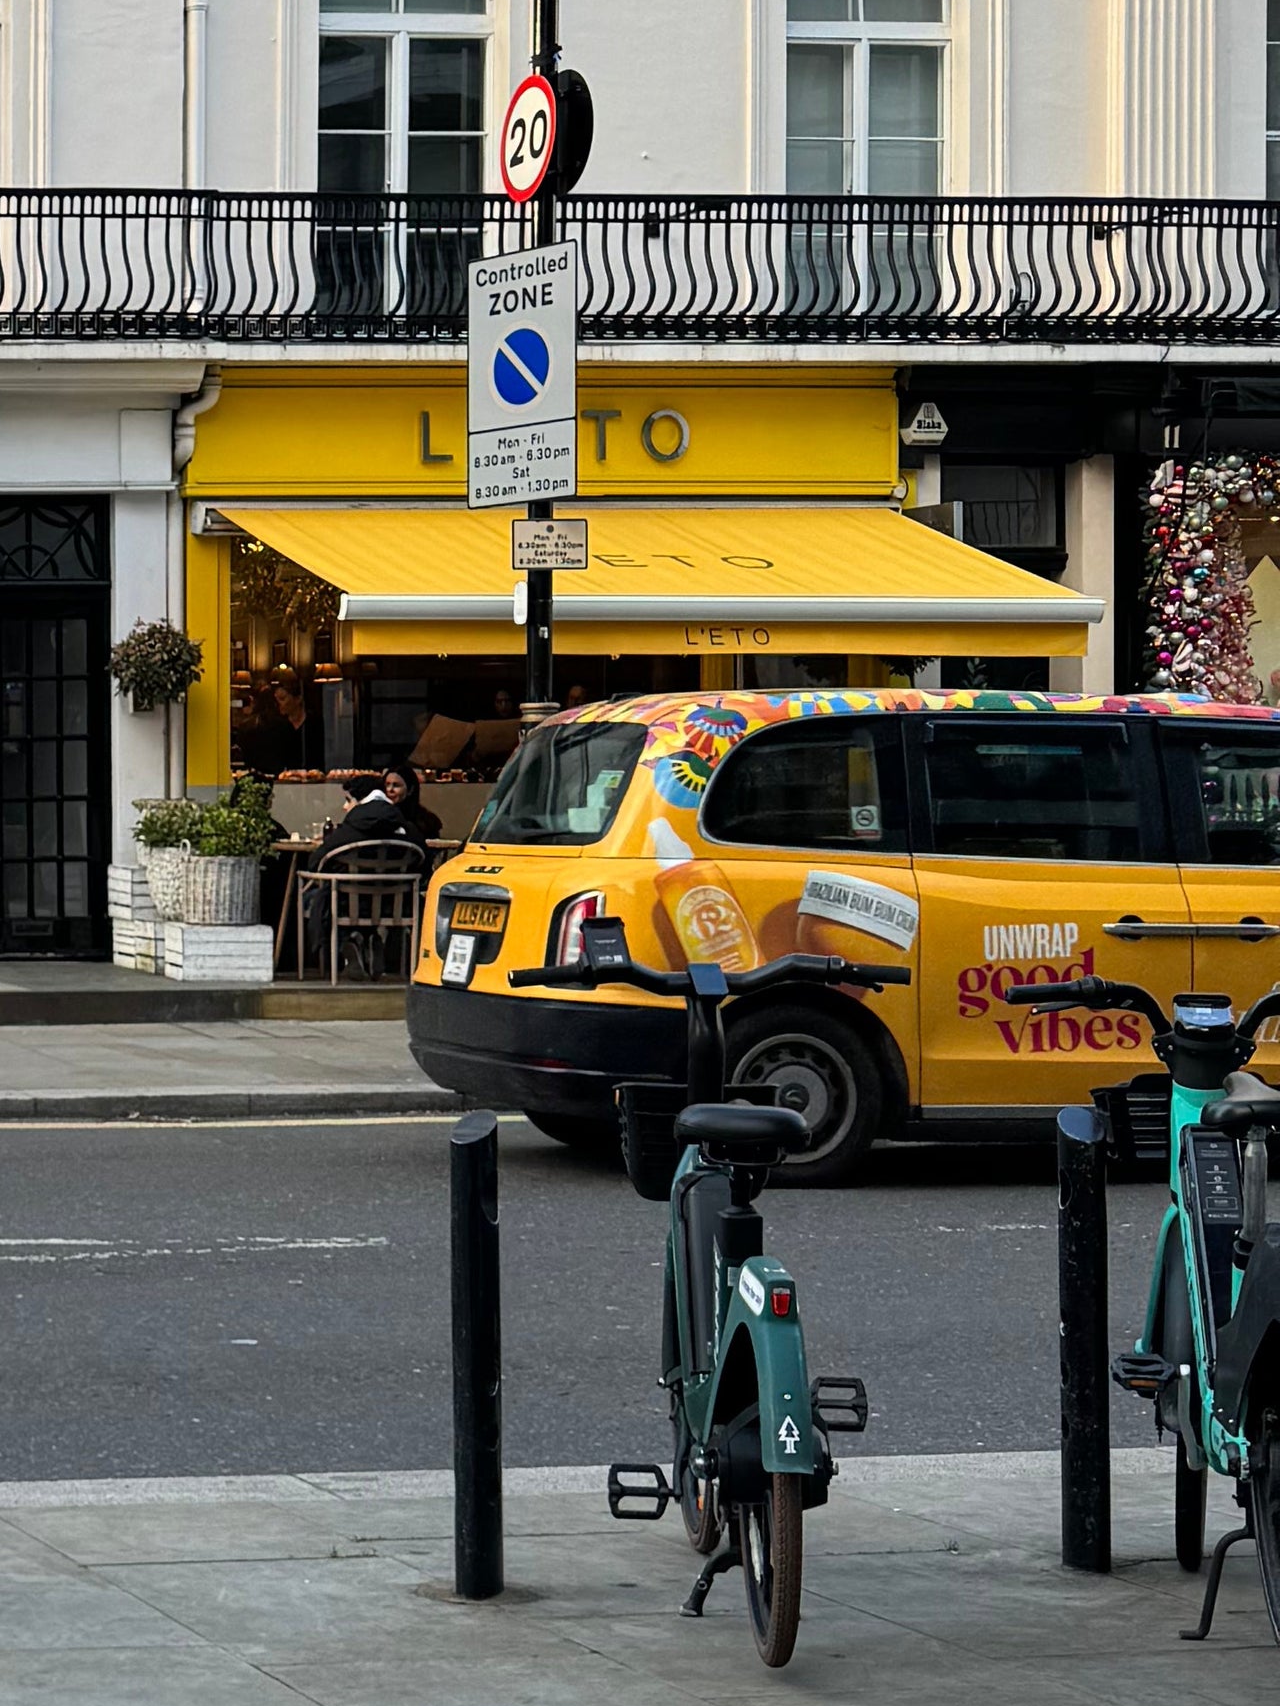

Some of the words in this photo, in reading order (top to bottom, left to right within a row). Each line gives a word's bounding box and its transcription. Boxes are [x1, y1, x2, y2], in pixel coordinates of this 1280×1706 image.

[509, 109, 548, 169] 20
[476, 250, 568, 287] Controlled
[489, 282, 554, 316] ZONE
[420, 408, 691, 464] LTO
[497, 437, 520, 450] Mon
[531, 432, 545, 445] Fri
[512, 466, 530, 479] Sat
[683, 626, 771, 646] L'ETO
[983, 922, 1079, 961] UNWRAP
[993, 1004, 1142, 1054] vibes
